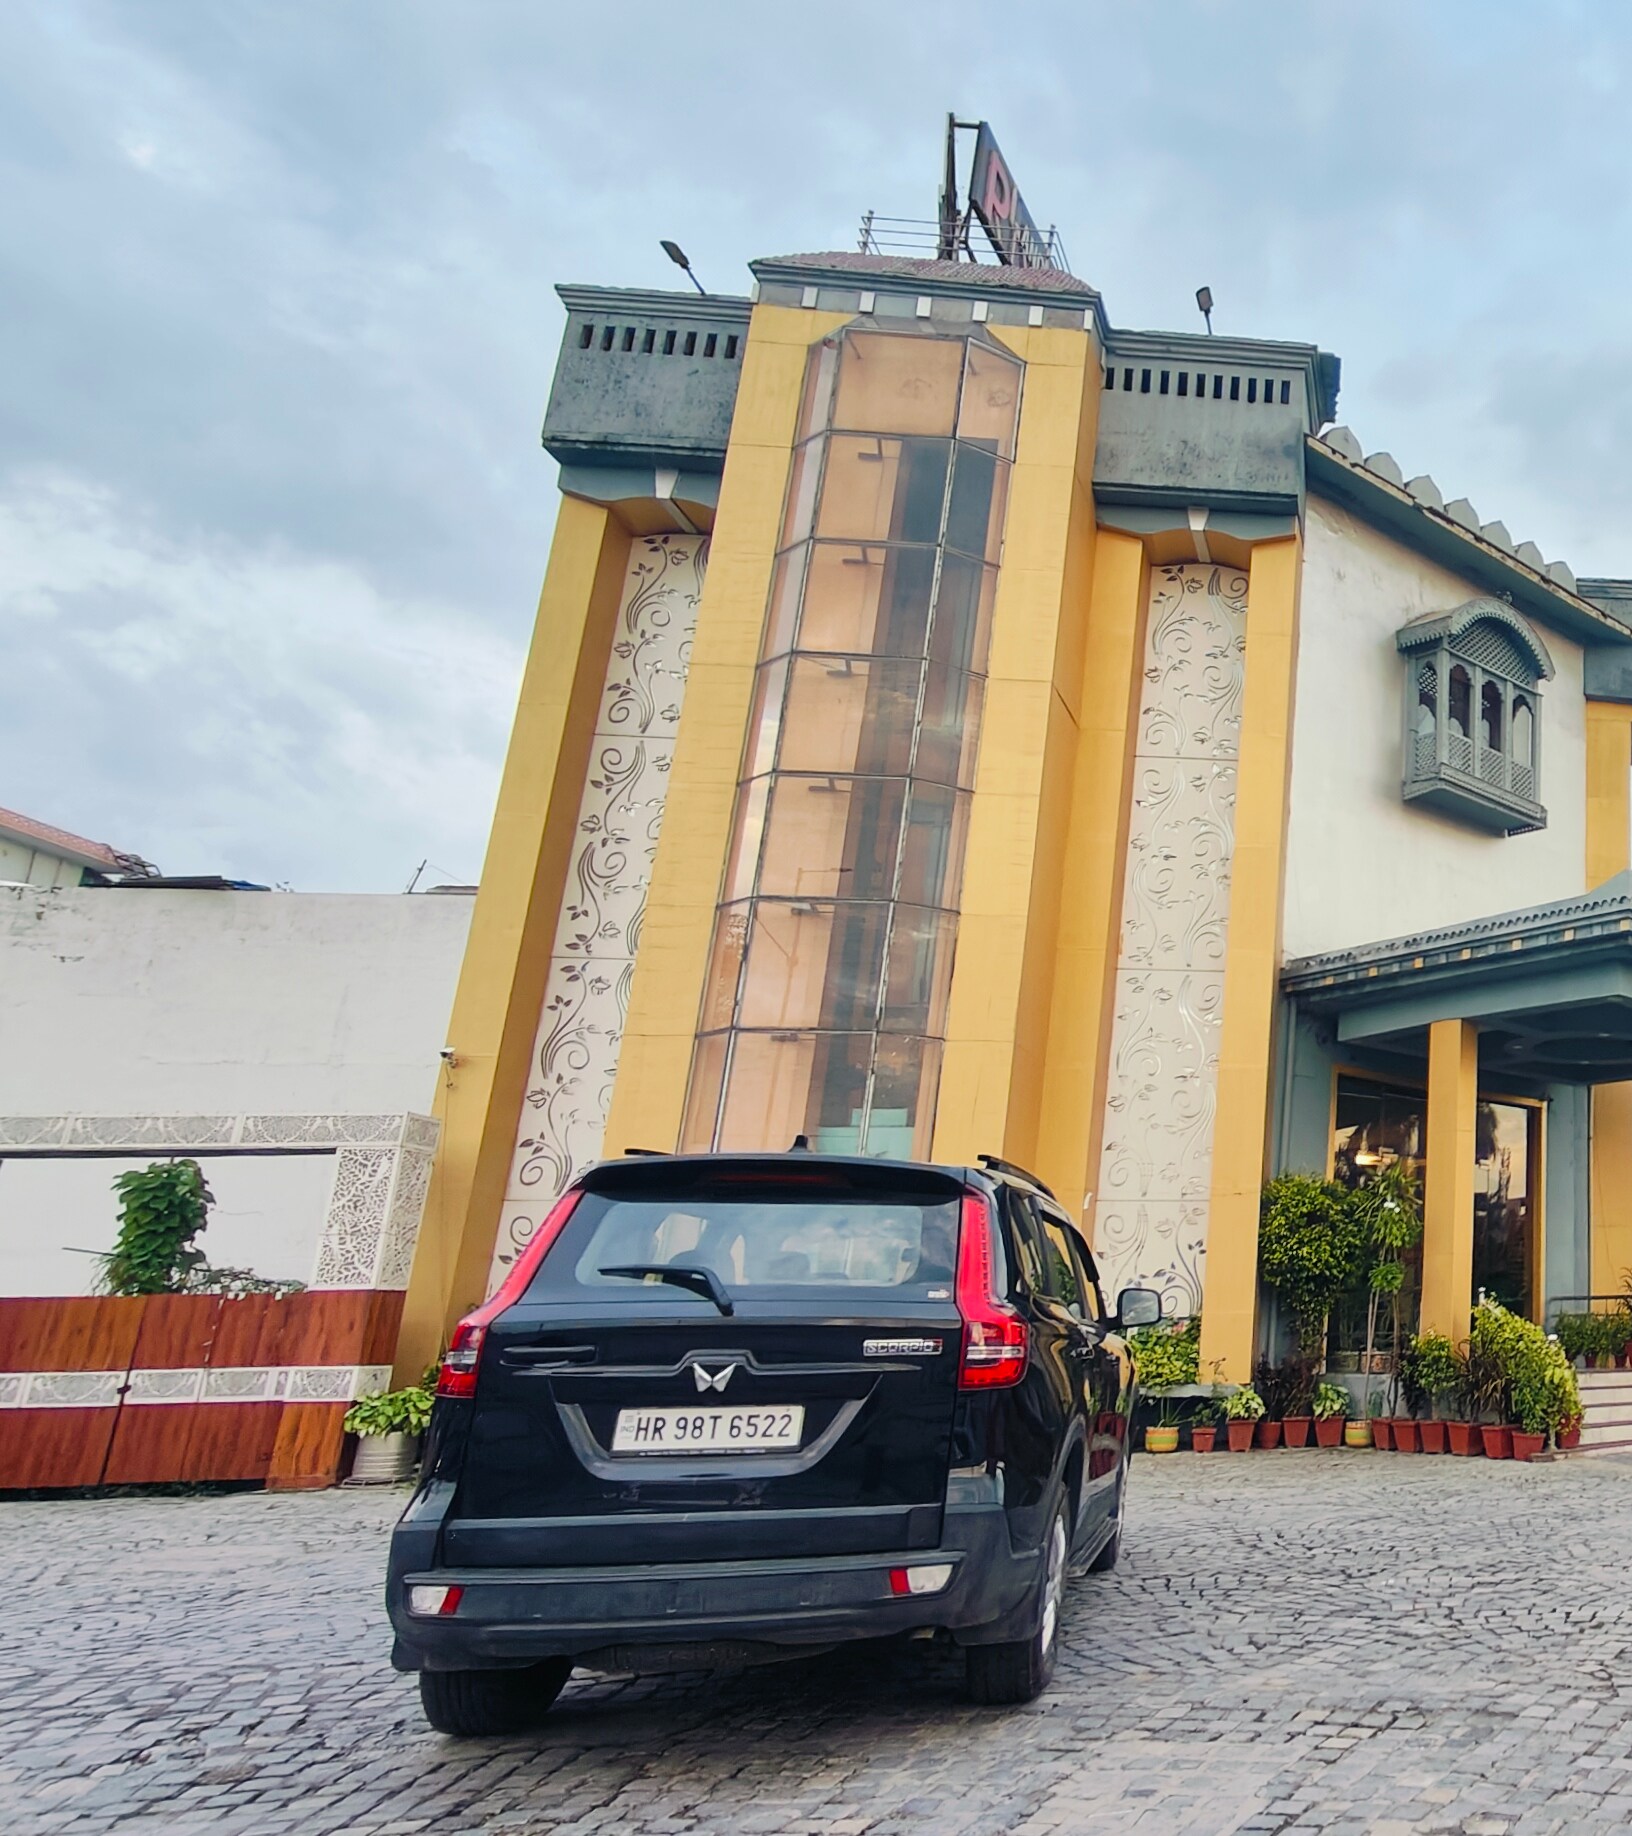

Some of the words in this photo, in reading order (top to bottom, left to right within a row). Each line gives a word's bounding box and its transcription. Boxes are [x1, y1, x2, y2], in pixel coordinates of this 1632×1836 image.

[634, 1416, 666, 1441] HR
[674, 1415, 722, 1440] 98T
[729, 1414, 792, 1439] 6522
